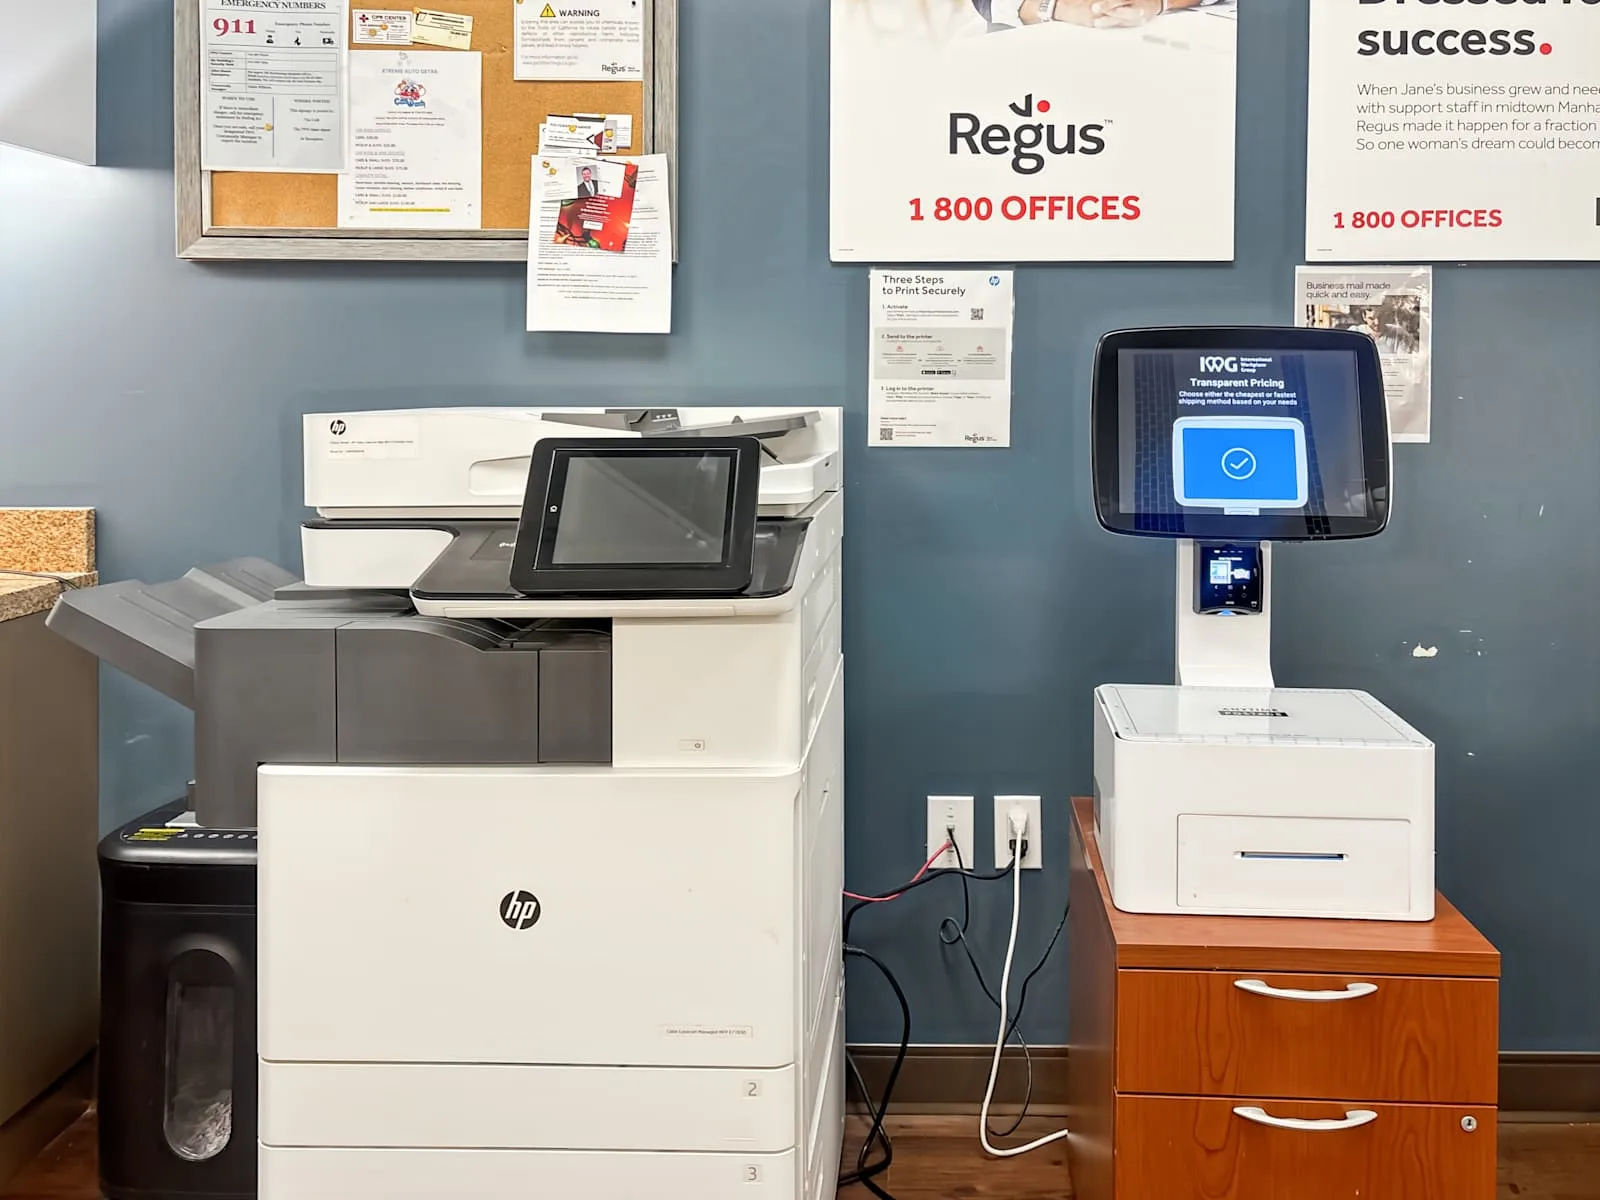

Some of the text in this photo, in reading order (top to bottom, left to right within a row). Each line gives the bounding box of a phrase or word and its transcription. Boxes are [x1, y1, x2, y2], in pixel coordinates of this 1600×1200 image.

[221, 0, 326, 9] EMERGENCY NUMBERS
[559, 9, 600, 17] WARNING
[213, 18, 256, 37] 911
[1357, 29, 1553, 56] success.
[1357, 83, 1398, 96] When
[1447, 83, 1506, 96] business
[1508, 86, 1543, 98] grew
[1544, 83, 1570, 96] and
[1573, 86, 1600, 96] nee
[1356, 101, 1386, 114] with
[1389, 101, 1443, 116] support
[1446, 101, 1481, 114] staff
[1481, 101, 1493, 114] in
[1496, 101, 1555, 114] midtown
[1356, 119, 1597, 134] Regus made it happen for a fraction
[1356, 137, 1376, 150] So
[1378, 140, 1405, 151] one
[1472, 137, 1516, 150] dream
[1518, 137, 1555, 150] could
[908, 196, 1141, 222] 1 800 OFFICES
[1334, 208, 1503, 229] 1 800 OFFICES
[882, 274, 944, 286] Three Steps
[1306, 281, 1391, 290] Business mail made
[882, 286, 966, 297] to Print Securely
[1306, 290, 1330, 300] quick
[1199, 356, 1238, 373] IWG
[1190, 377, 1285, 389] Transparent Pricing
[1178, 398, 1206, 407] shipping
[1206, 398, 1232, 406] method
[1232, 398, 1252, 406] based
[1262, 399, 1277, 407] your
[1277, 398, 1298, 406] needs
[1235, 391, 1265, 400] cheapest
[330, 420, 347, 435] hp
[501, 890, 540, 930] hp
[747, 1082, 758, 1097] 2
[747, 1166, 758, 1181] 3
